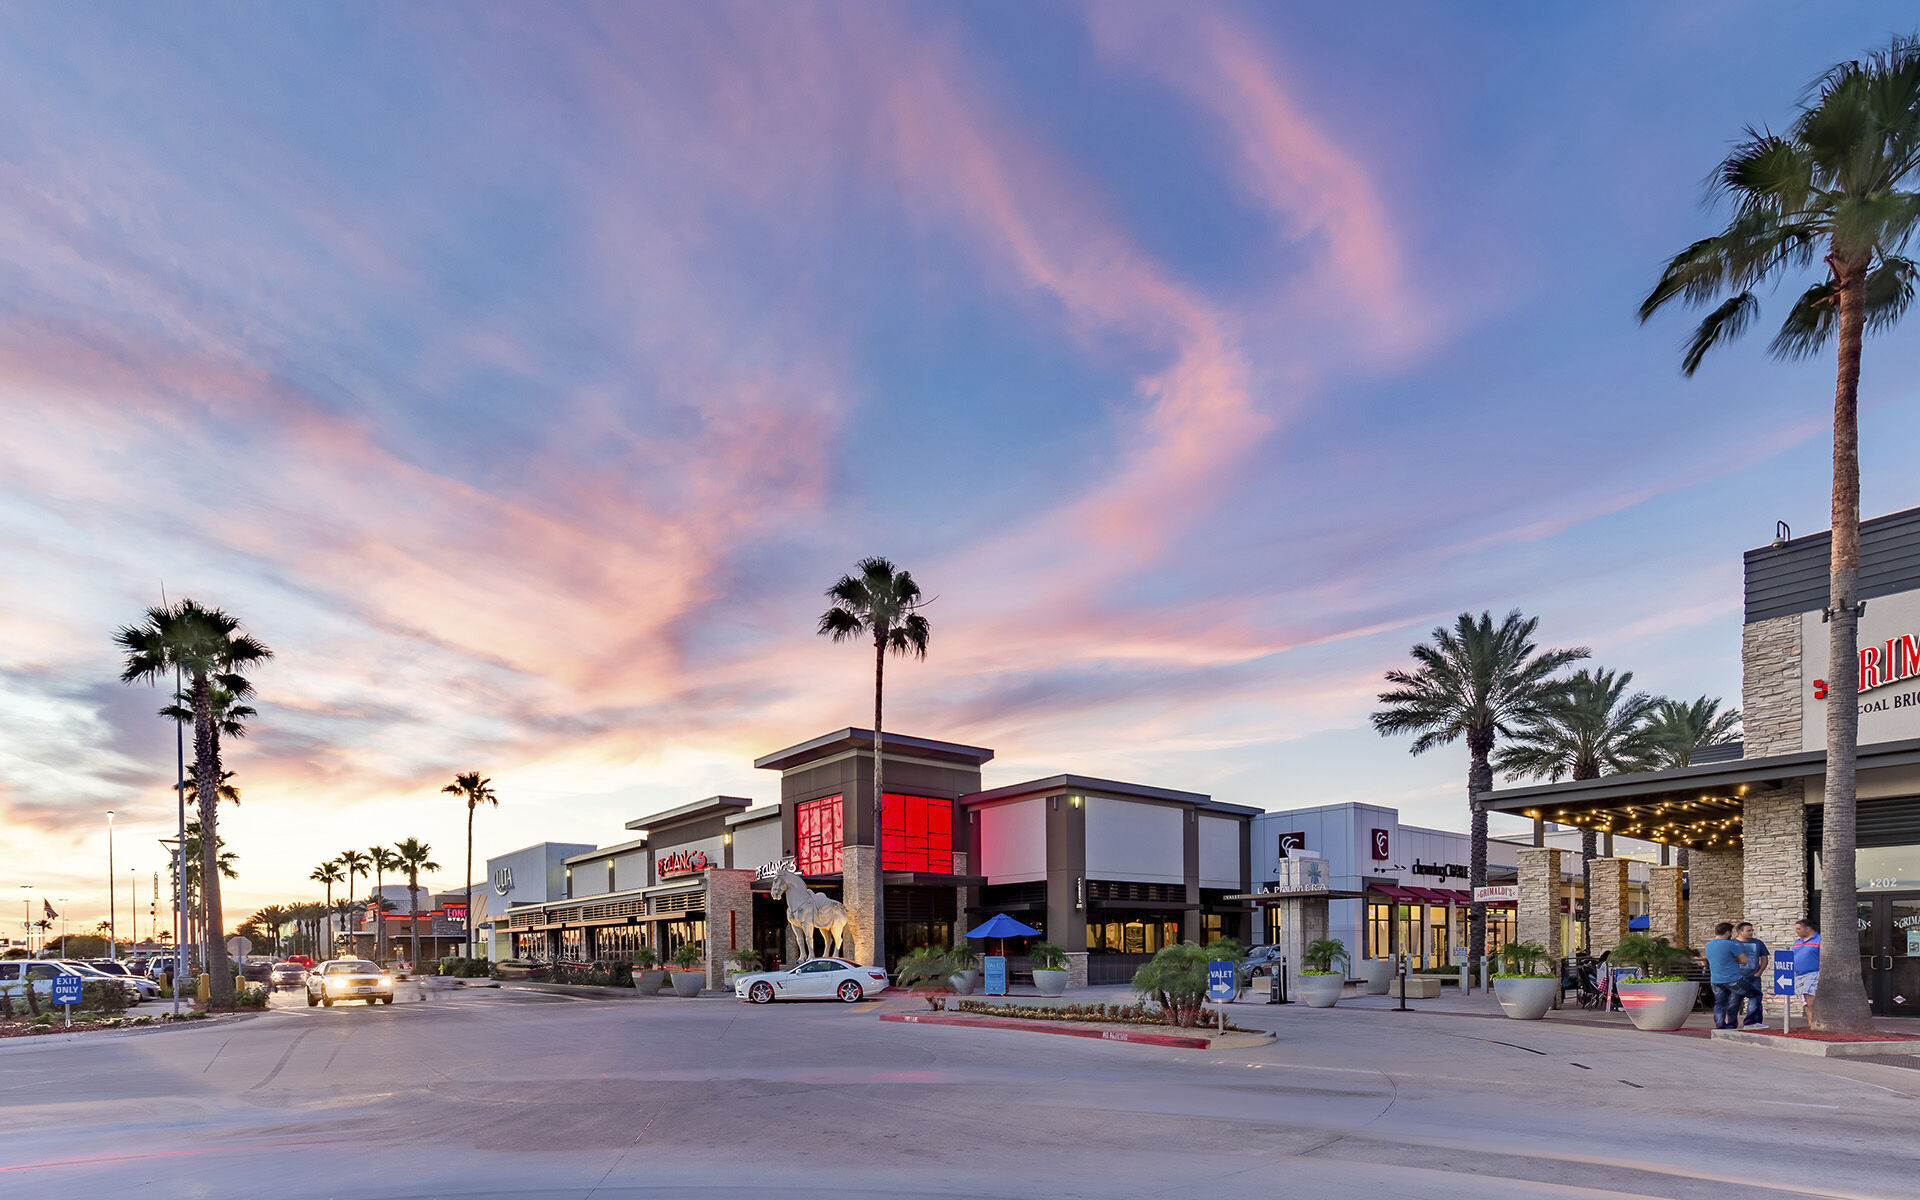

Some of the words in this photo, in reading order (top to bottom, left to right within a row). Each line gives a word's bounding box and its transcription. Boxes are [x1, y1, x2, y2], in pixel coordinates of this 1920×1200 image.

[494, 866, 514, 896] ULTA
[1257, 887, 1270, 895] LA
[1274, 883, 1327, 893] PALMERA
[1479, 887, 1512, 898] GRIMALDI'S
[1775, 961, 1794, 971] VALET
[1210, 970, 1233, 978] VALET
[56, 977, 78, 985] EXIT
[55, 986, 78, 994] ONLY
